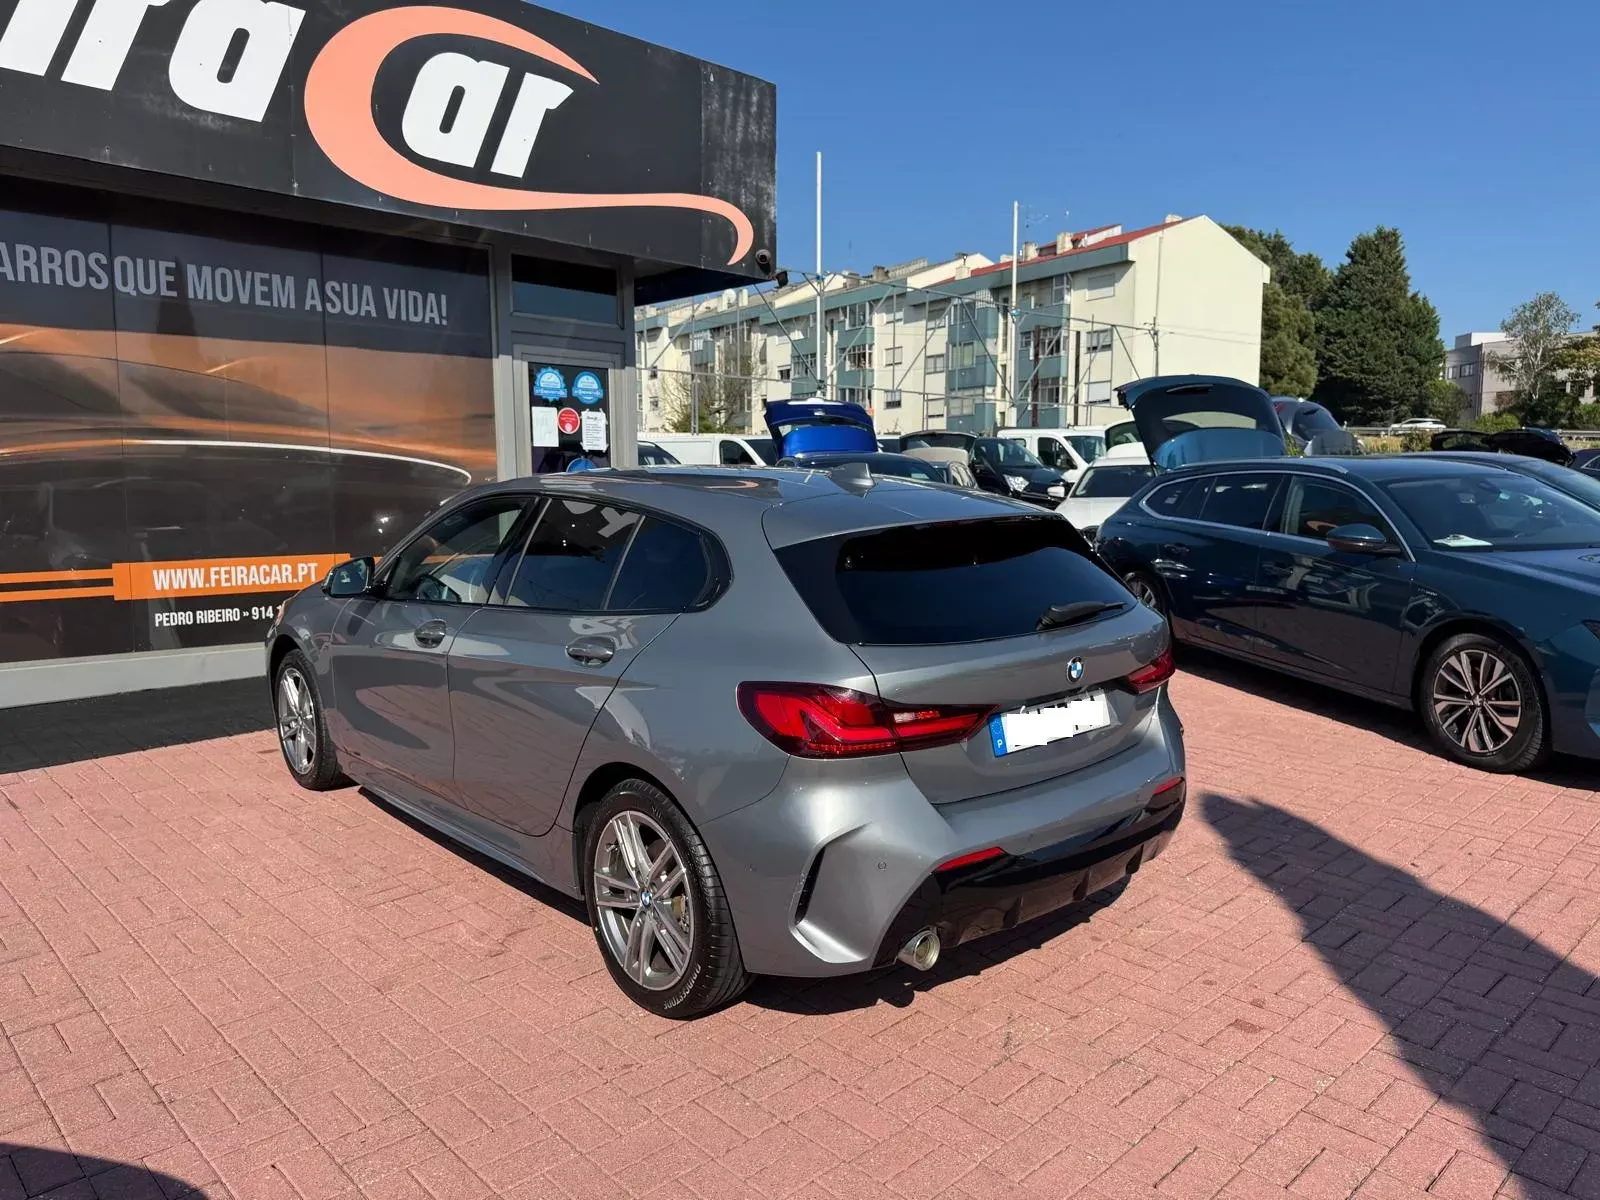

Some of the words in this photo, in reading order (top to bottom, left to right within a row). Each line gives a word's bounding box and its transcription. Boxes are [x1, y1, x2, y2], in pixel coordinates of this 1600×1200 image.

[114, 255, 178, 296] QUE
[186, 263, 296, 309] MOVEM
[383, 287, 448, 326] VIDA!
[152, 562, 318, 591] WWW.FEIRACAR.PT
[154, 612, 194, 627] PEDRO
[196, 608, 240, 624] RIBEIRO
[251, 605, 275, 620] 914
